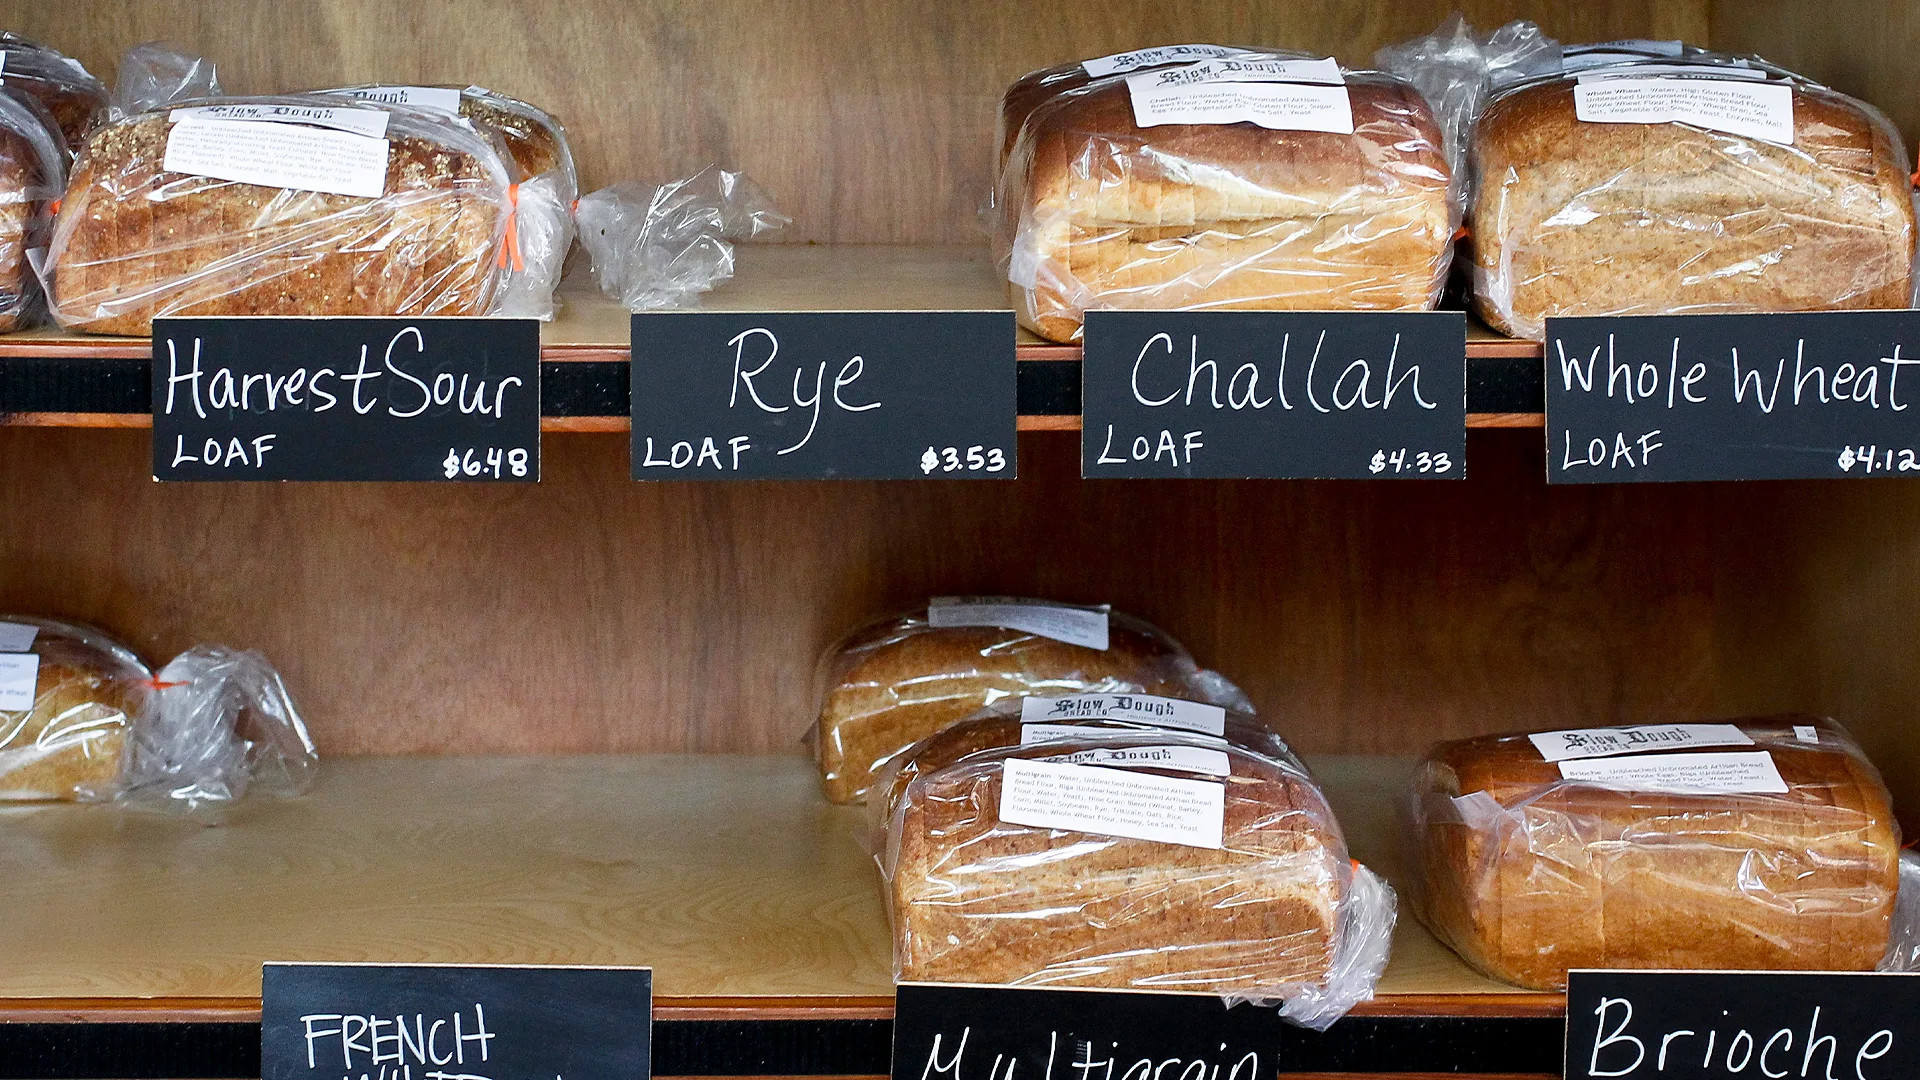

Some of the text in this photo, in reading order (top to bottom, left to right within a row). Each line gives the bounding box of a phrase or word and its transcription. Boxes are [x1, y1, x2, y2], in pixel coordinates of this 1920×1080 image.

[1156, 61, 1286, 86] Slow Dough
[263, 107, 334, 119] Dough
[1131, 329, 1437, 413] Challah
[1555, 333, 1920, 414] Whole Wheat
[727, 327, 882, 456] Rye
[170, 434, 277, 468] LOAF
[642, 435, 751, 471] LOAF
[920, 444, 1007, 475] $3.53
[1096, 424, 1204, 468] LOAF
[1368, 447, 1453, 475] $4.33
[1561, 429, 1663, 471] LOAF
[1837, 445, 1920, 474] $4.12
[442, 447, 528, 480] $6.48
[1047, 696, 1174, 715] Slow Dough
[1562, 727, 1692, 750] Slow Dough
[1103, 749, 1171, 761] Dough
[1015, 771, 1051, 779] Multigrain
[1084, 776, 1124, 788] Unbleached
[1126, 781, 1169, 793] Unbromated
[1015, 778, 1035, 786] Bread
[1128, 800, 1147, 808] Blend
[1074, 812, 1095, 820] Wheat
[1180, 824, 1199, 832] Yeast
[300, 1002, 496, 1070] FRENCH
[1588, 996, 1894, 1080] Brioche
